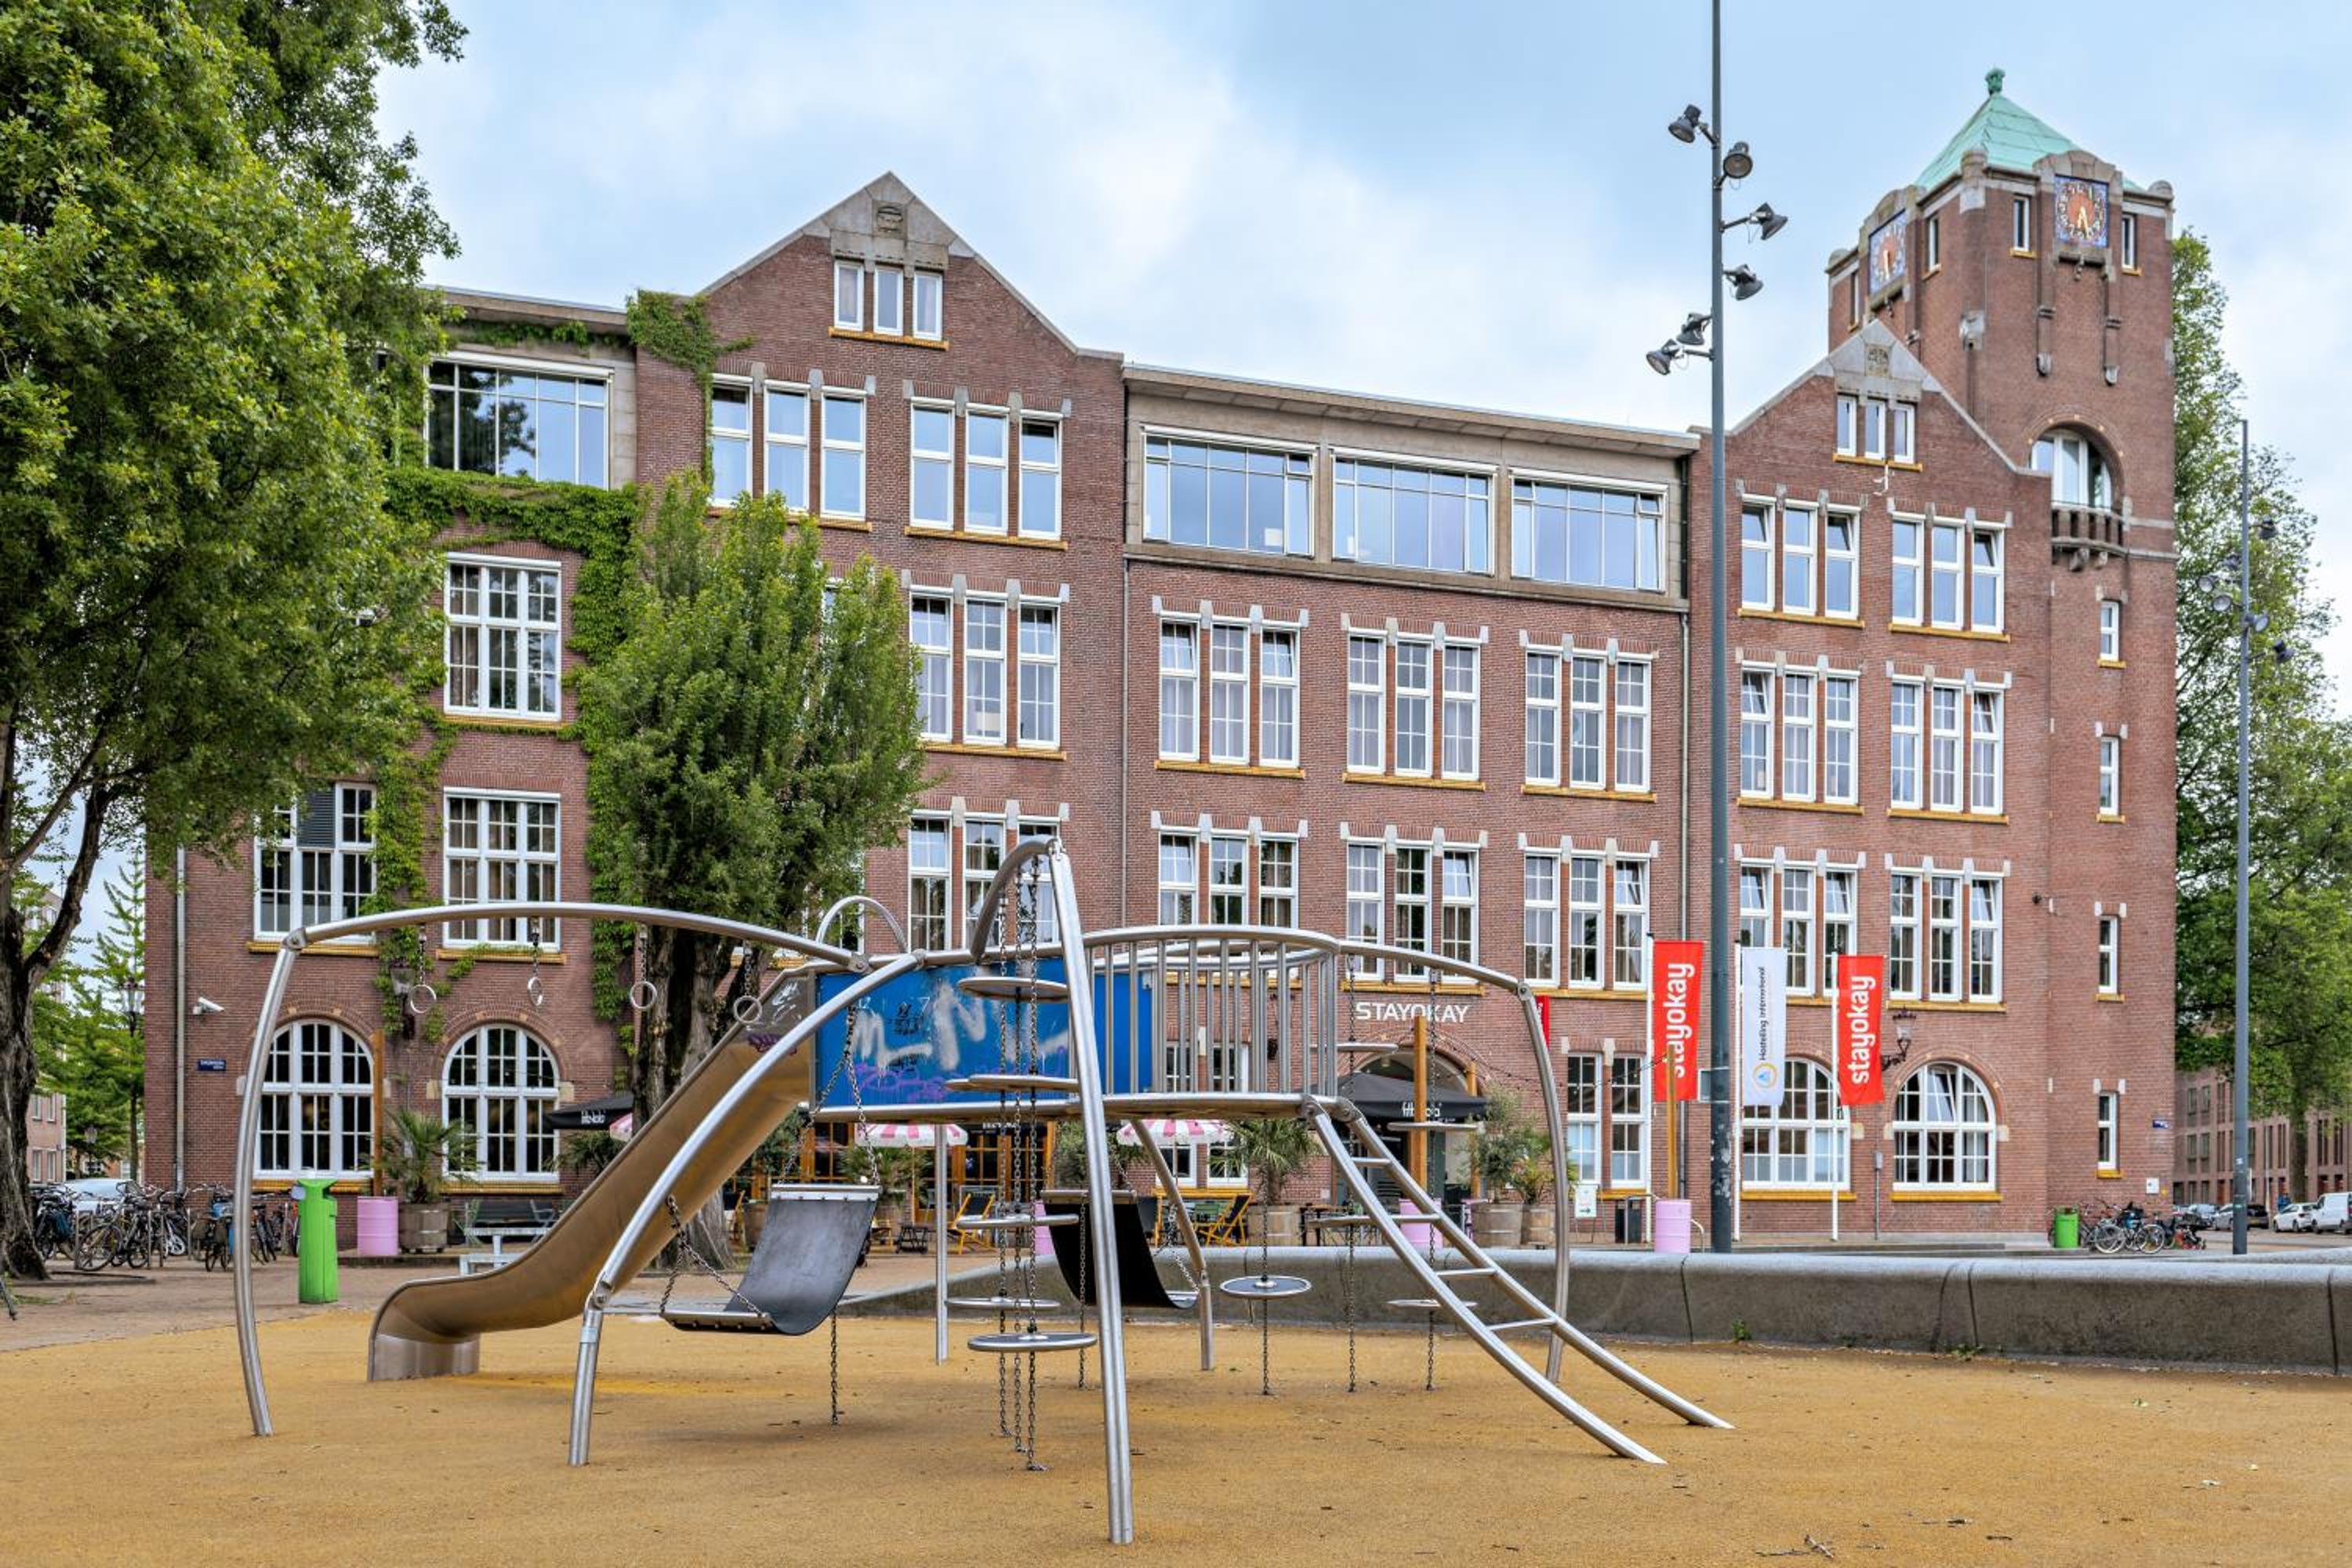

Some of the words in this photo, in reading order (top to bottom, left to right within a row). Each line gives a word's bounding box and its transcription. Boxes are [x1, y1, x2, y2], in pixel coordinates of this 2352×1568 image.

[1356, 1002, 1469, 1023] STAYOKAY
[1757, 967, 1766, 1018] International
[1759, 1020, 1769, 1061] Hostelling
[1846, 975, 1876, 1084] stayokay
